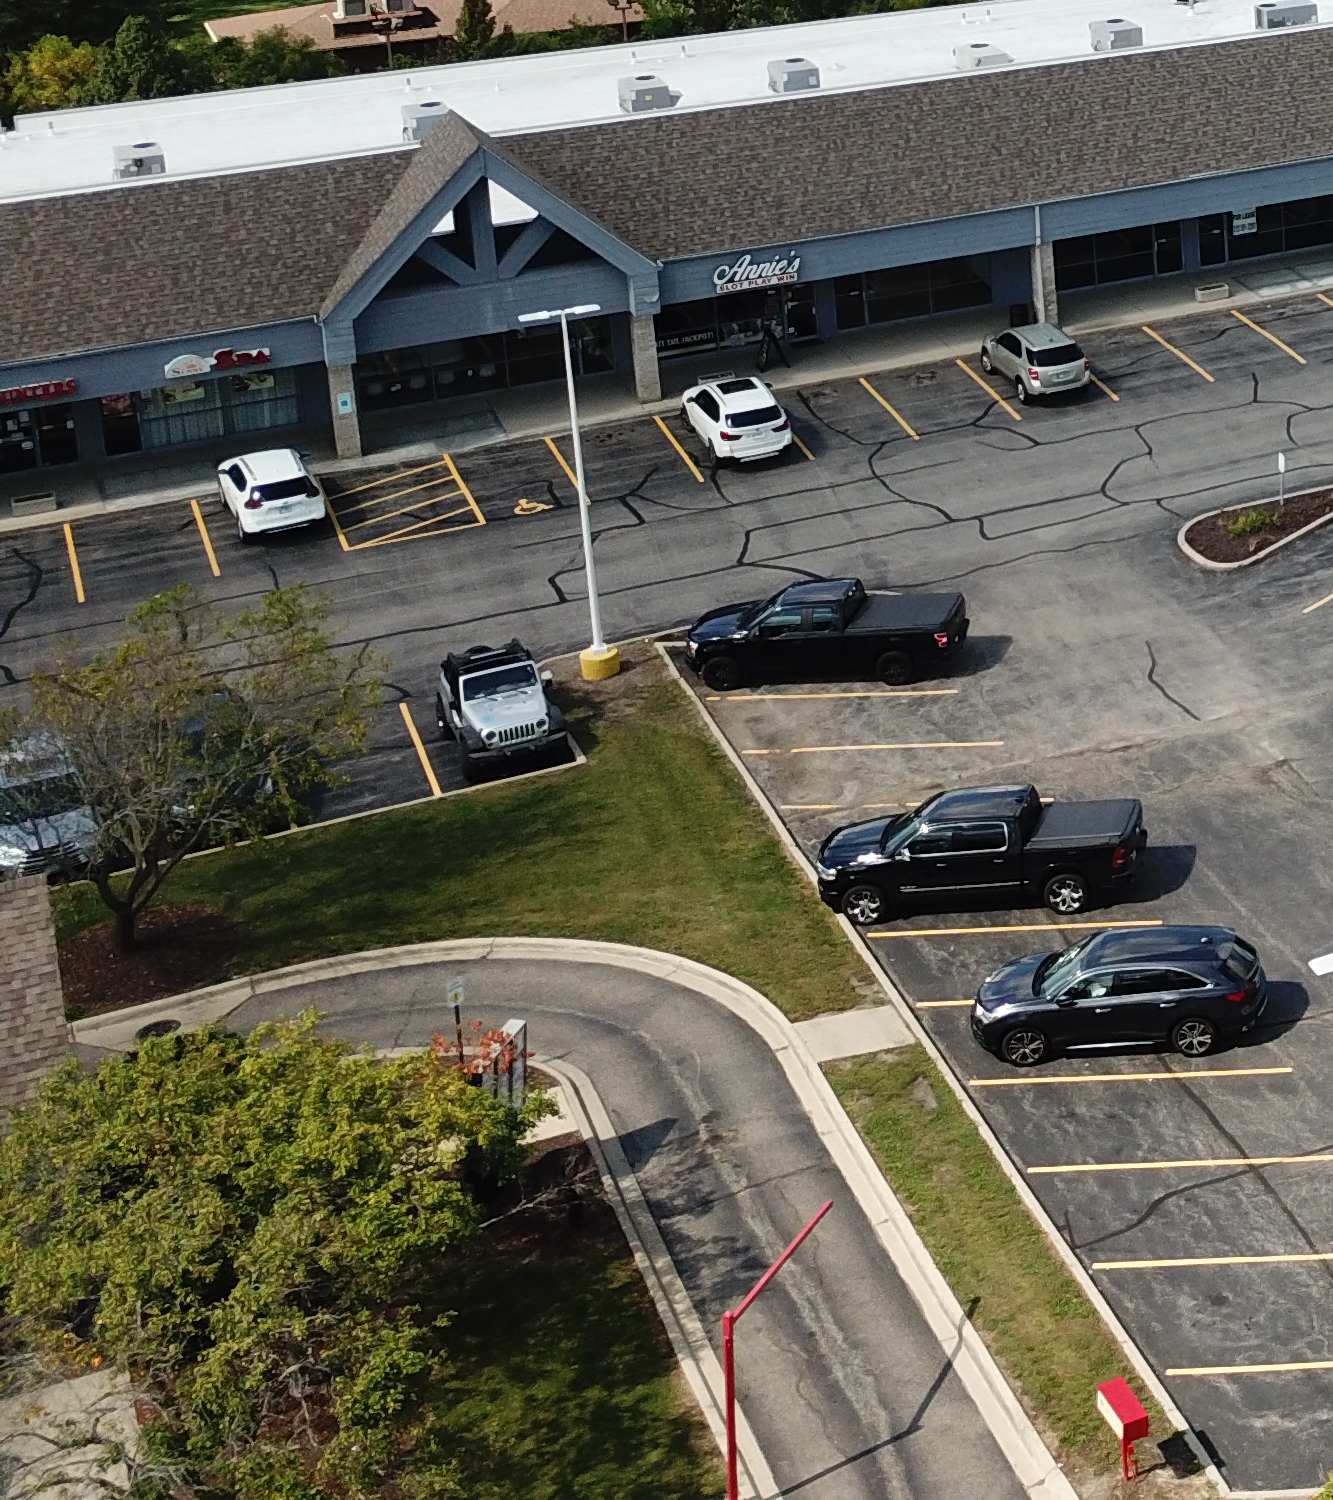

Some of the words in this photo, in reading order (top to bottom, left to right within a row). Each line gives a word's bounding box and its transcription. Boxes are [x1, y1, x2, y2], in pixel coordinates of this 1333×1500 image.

[713, 250, 801, 285] Annie's
[719, 283, 744, 292] SLOT
[748, 279, 772, 287] PLAY
[776, 273, 796, 282] WIN
